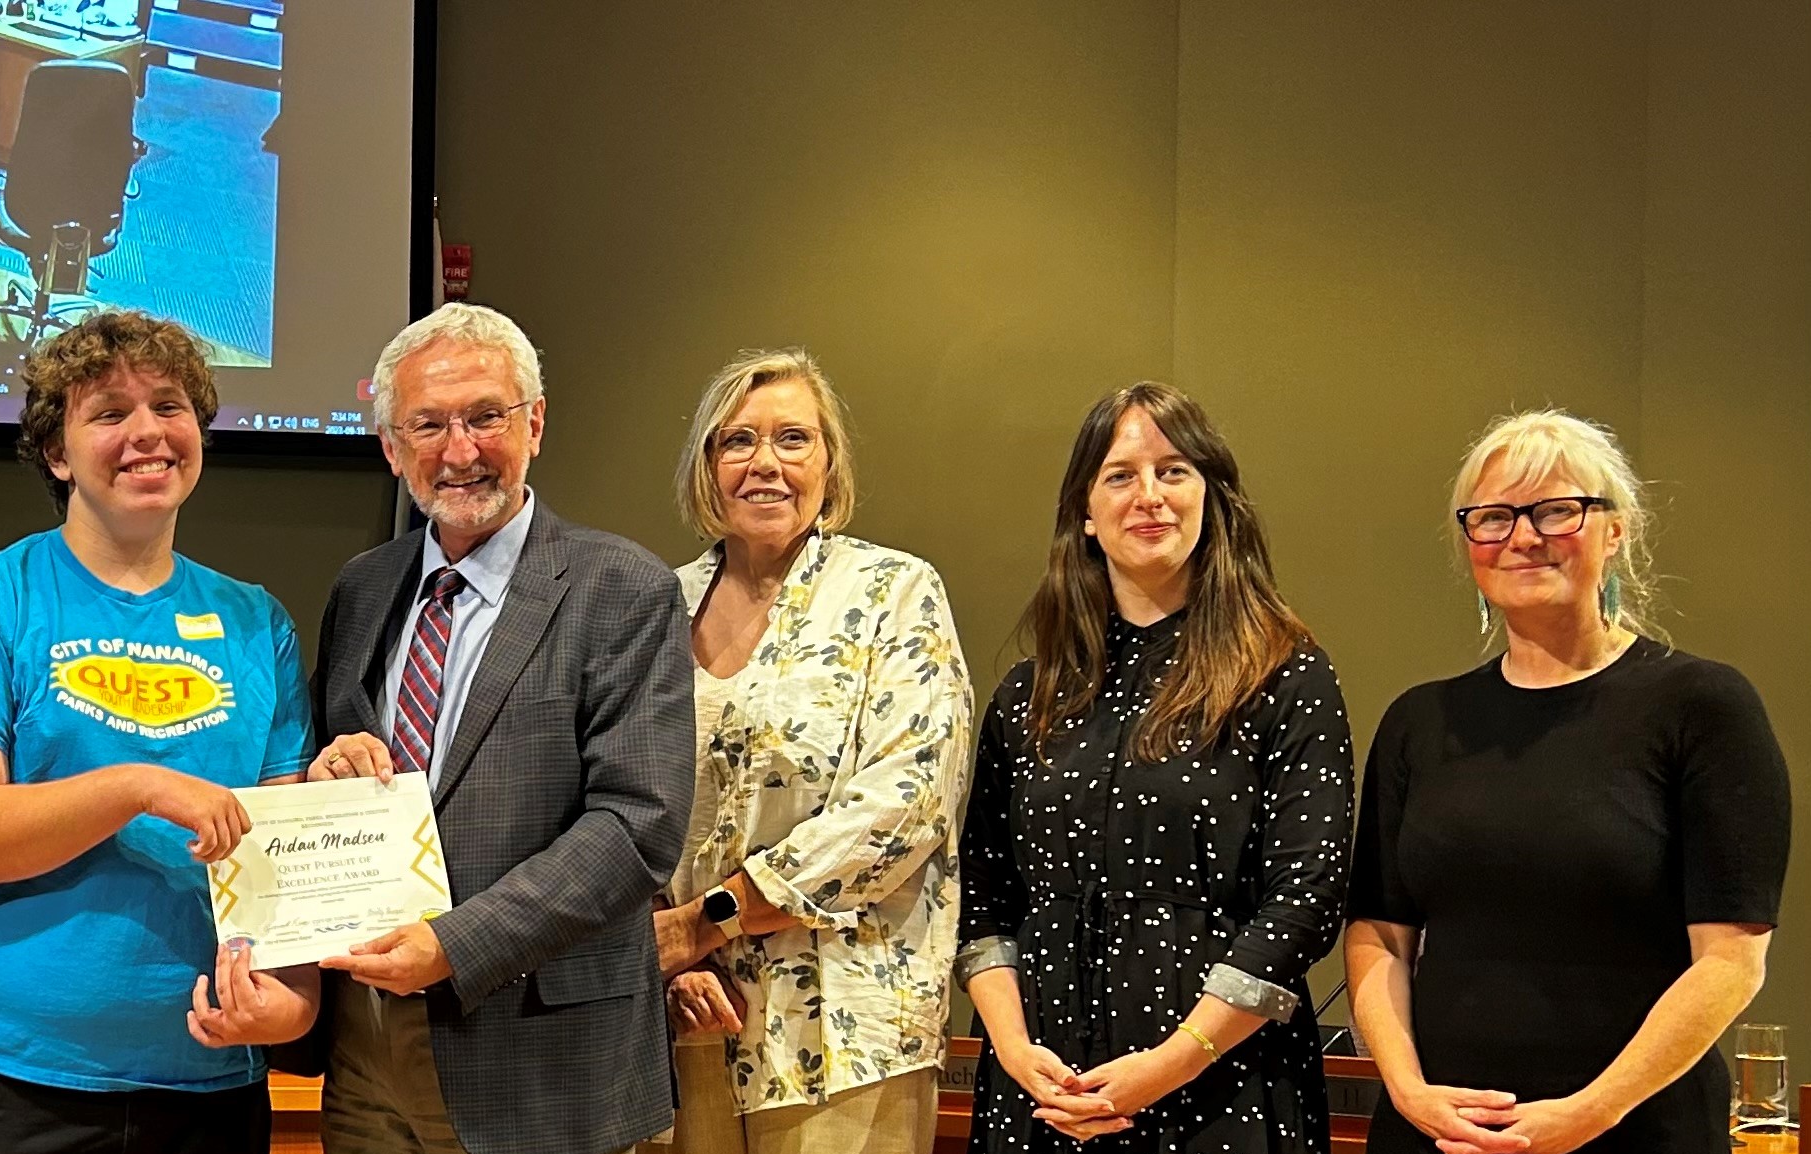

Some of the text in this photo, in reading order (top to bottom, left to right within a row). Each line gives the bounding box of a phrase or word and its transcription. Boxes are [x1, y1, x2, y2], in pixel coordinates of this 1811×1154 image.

[444, 267, 468, 277] FIRE
[301, 418, 320, 429] ENG
[348, 412, 362, 423] PM
[50, 638, 224, 681] CITY OF NANAIMO
[78, 665, 197, 702] QUEST
[99, 688, 131, 707] YOUTH
[56, 690, 229, 740] PARKS AND RECREATION
[265, 829, 386, 857] Aidan Madsen
